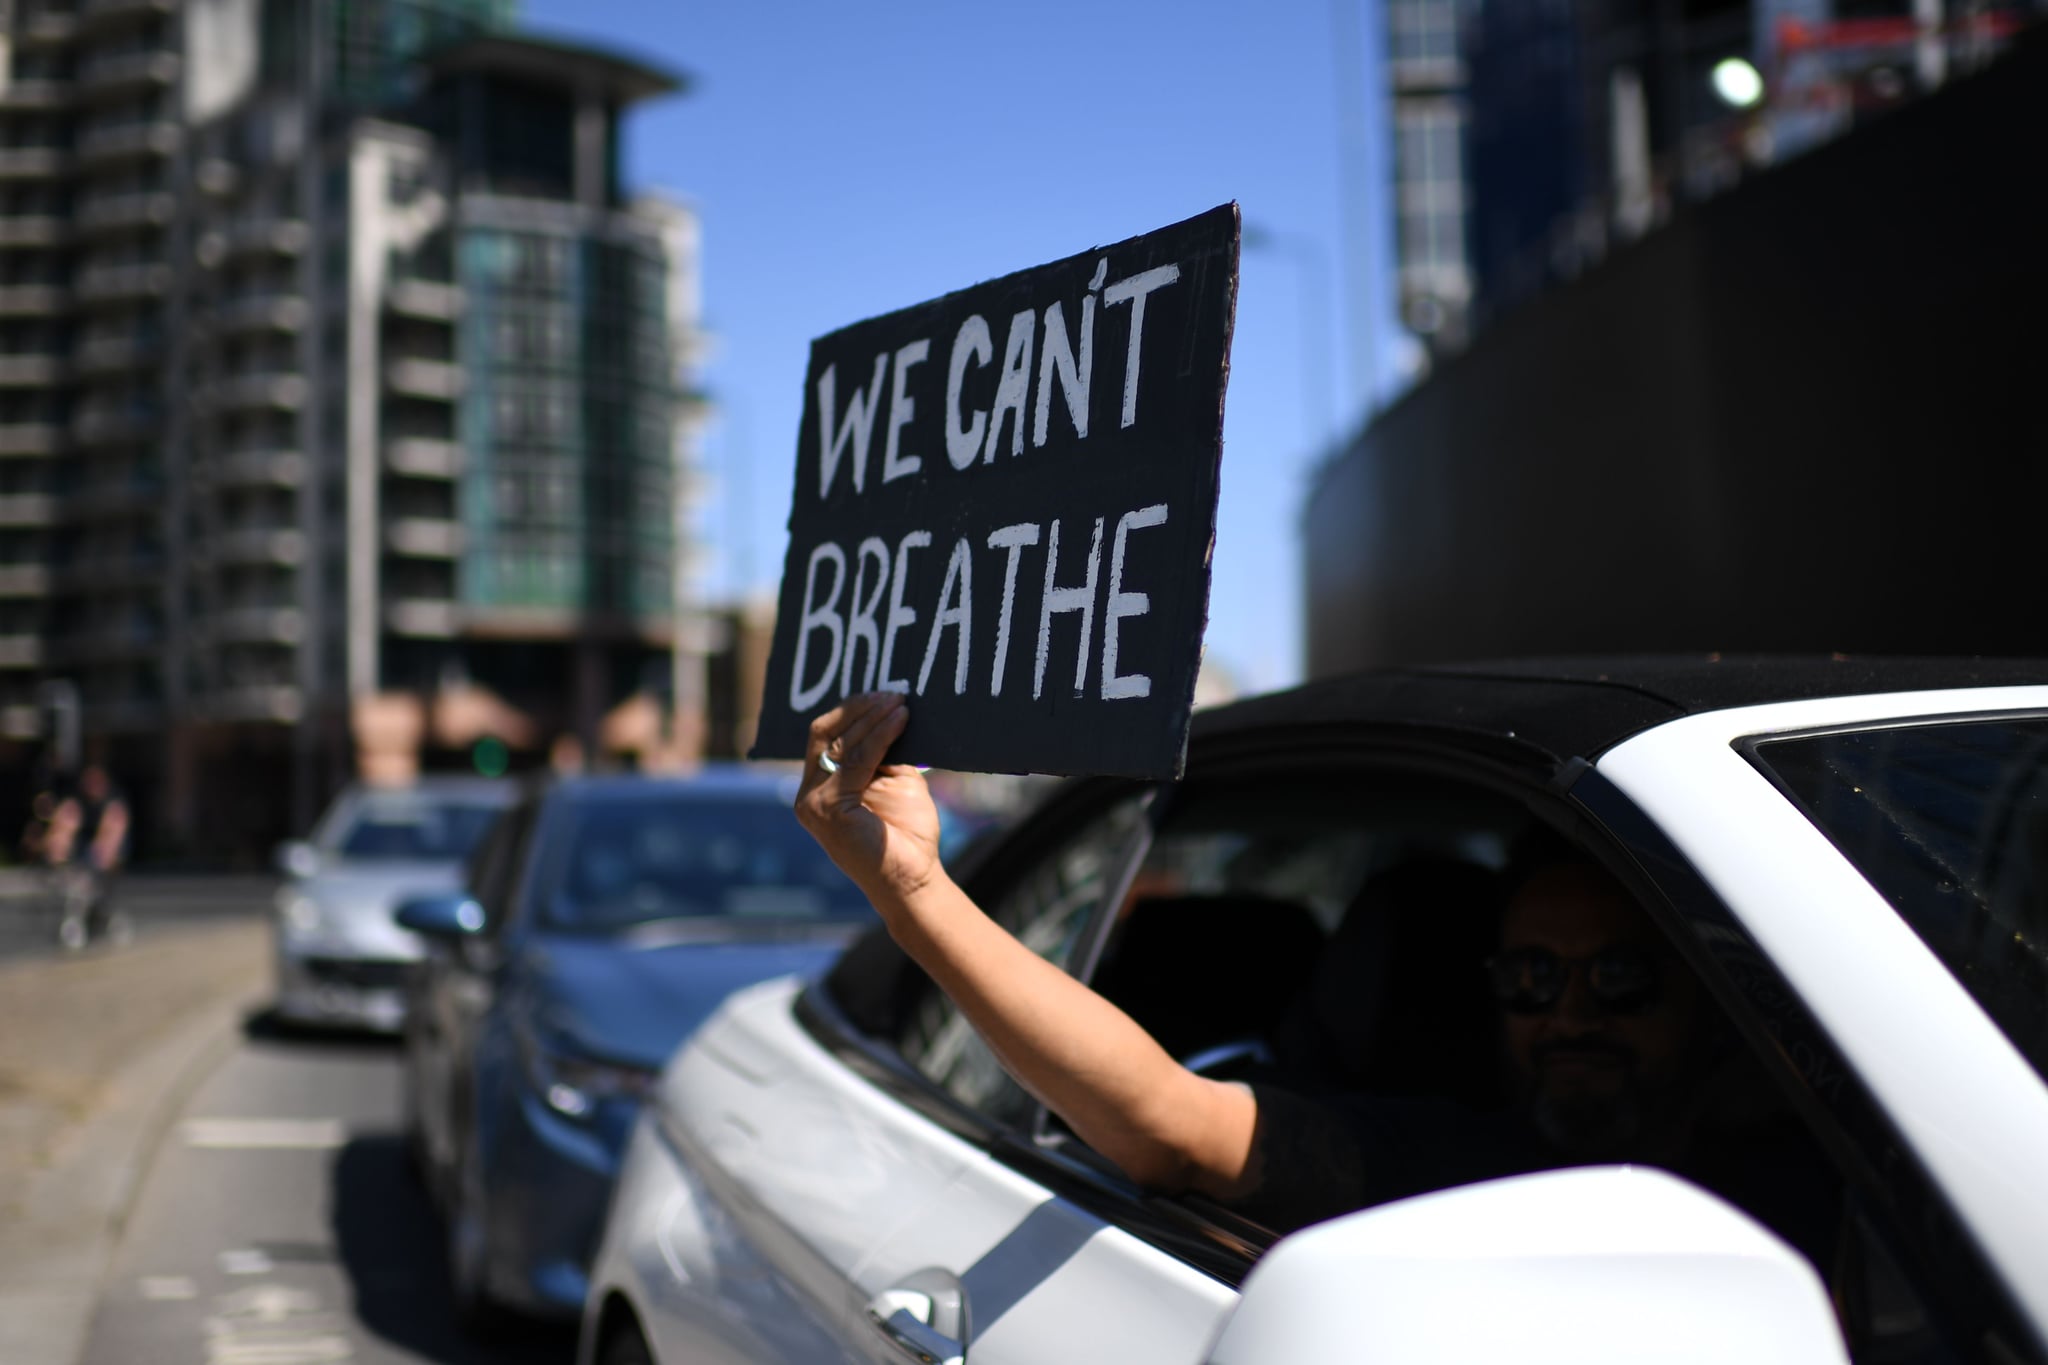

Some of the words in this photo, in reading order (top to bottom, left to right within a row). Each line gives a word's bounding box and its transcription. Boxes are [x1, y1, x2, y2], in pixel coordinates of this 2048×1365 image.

[818, 338, 930, 499] WE
[945, 256, 1181, 471] CAN'T
[789, 503, 1169, 711] BREATHE
